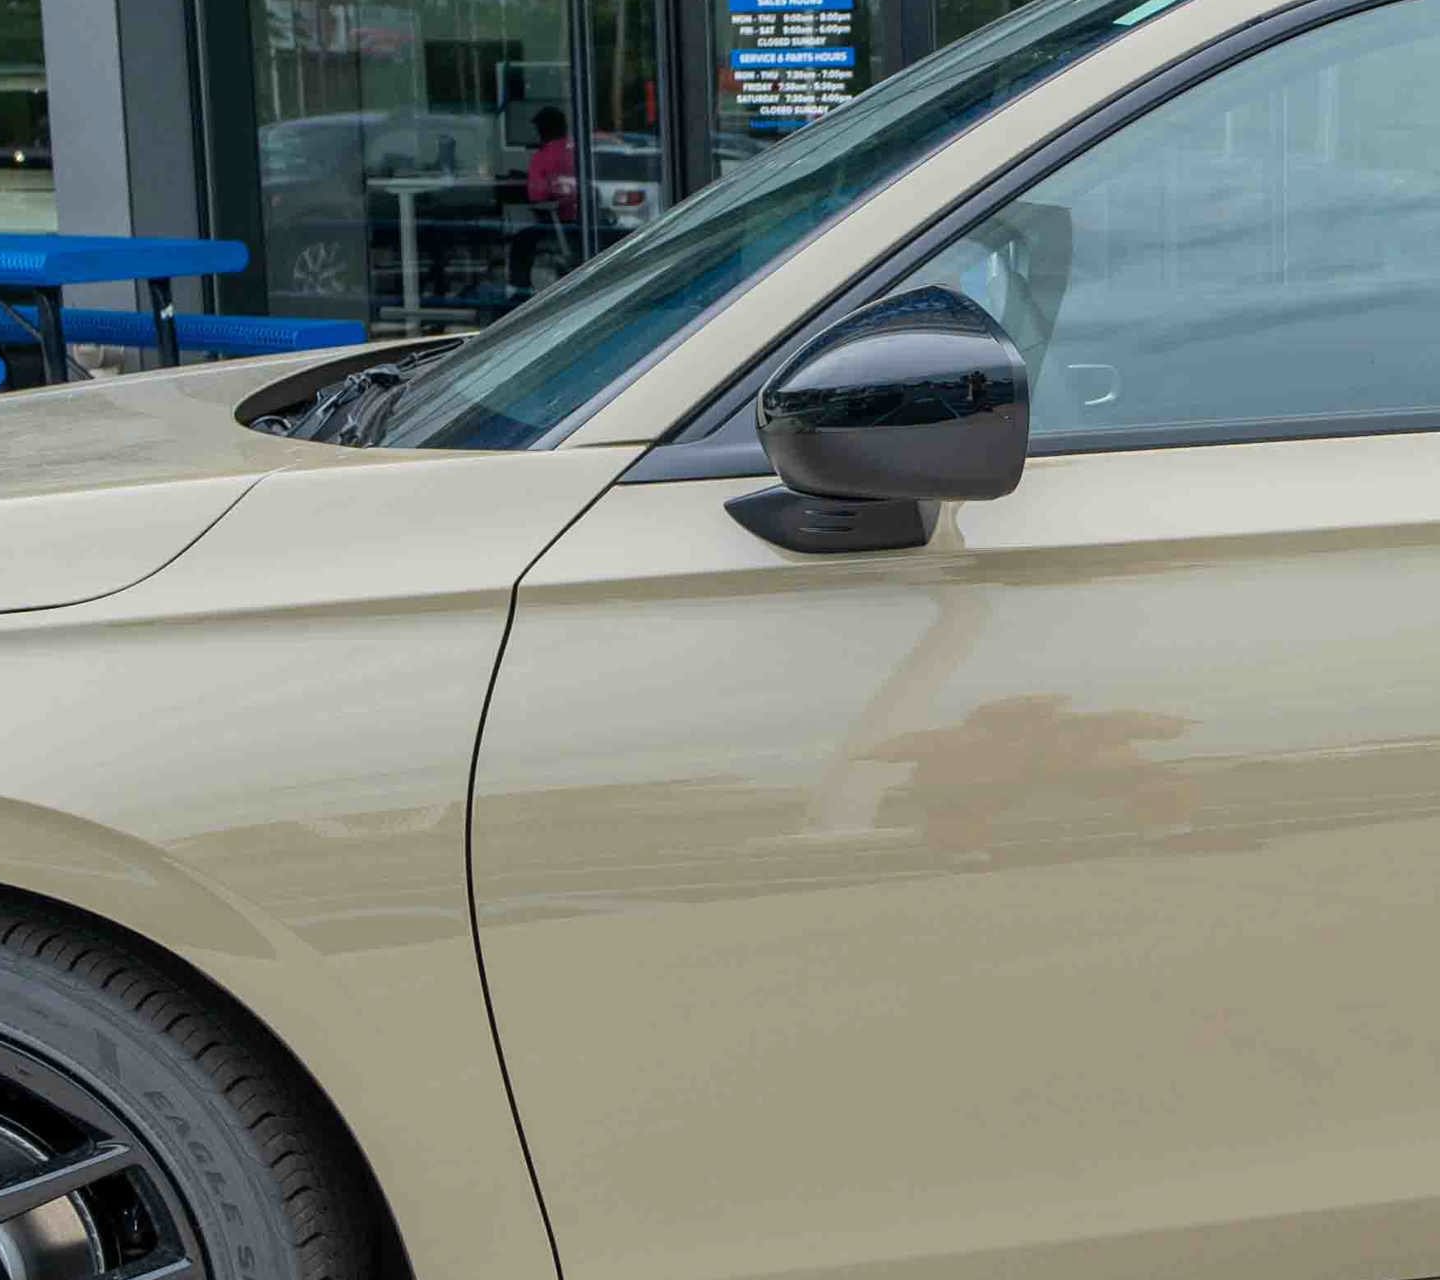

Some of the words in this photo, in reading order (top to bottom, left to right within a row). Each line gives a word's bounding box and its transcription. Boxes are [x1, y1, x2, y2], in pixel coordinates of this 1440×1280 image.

[757, 38, 790, 47] CLOSED
[792, 37, 826, 47] SUNDAY
[739, 53, 775, 64] SERVICE
[785, 52, 814, 62] PARTS
[815, 51, 848, 61] HOURS
[736, 95, 780, 104] SATURDAY
[759, 106, 792, 115] CLOSED
[794, 106, 829, 115] SUNDAY
[143, 1090, 246, 1227] EAGLE
